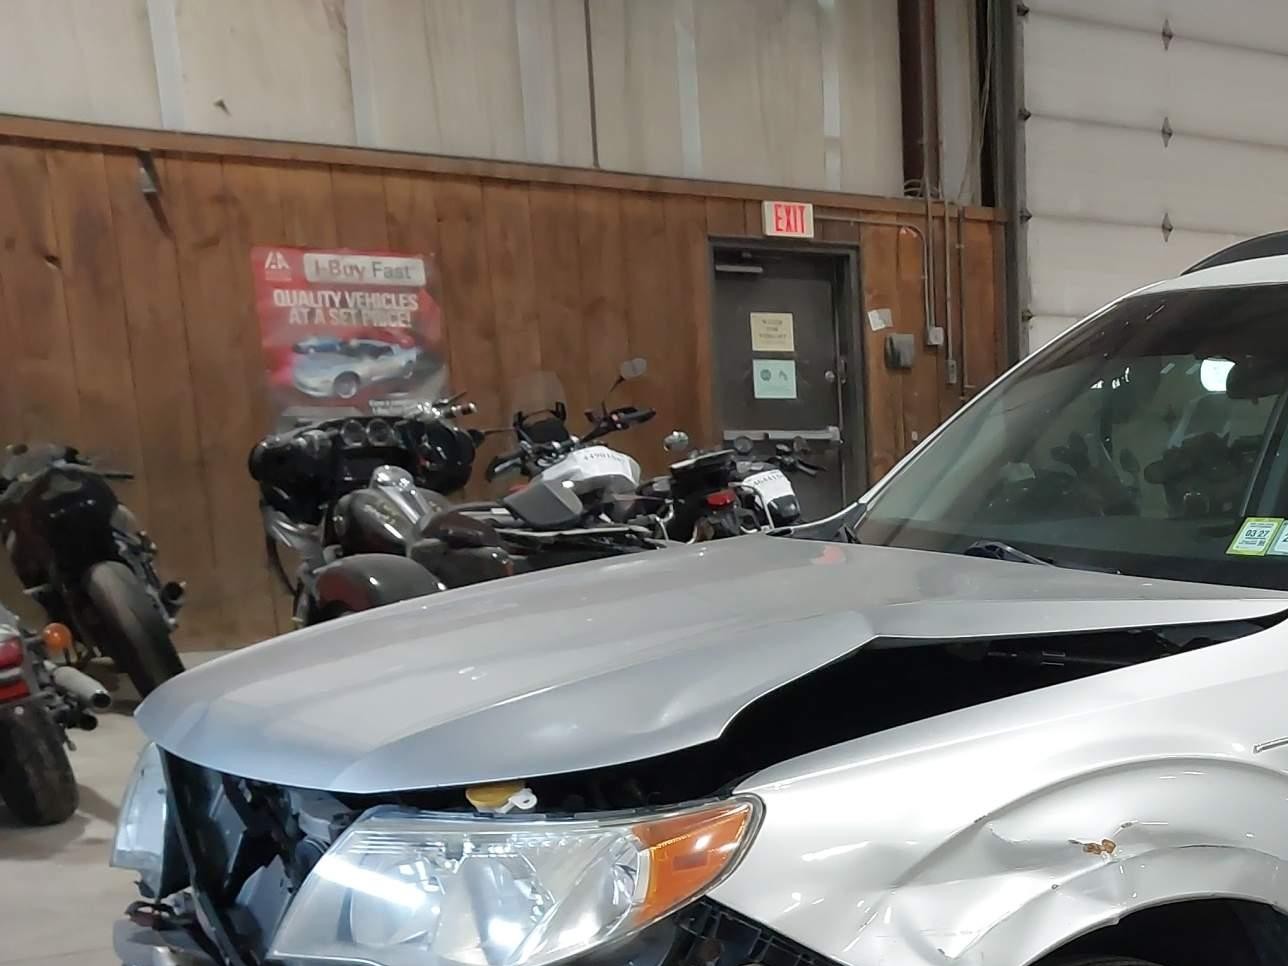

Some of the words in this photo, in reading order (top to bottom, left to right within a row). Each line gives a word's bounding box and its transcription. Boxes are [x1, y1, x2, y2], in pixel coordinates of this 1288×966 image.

[774, 203, 806, 234] EXIT
[314, 259, 365, 280] I-Buy
[371, 261, 413, 280] Fast
[273, 289, 342, 308] QUALITY
[345, 292, 419, 311] VEHICLES
[289, 308, 312, 325] AT
[314, 309, 326, 325] A
[328, 309, 356, 327] SET
